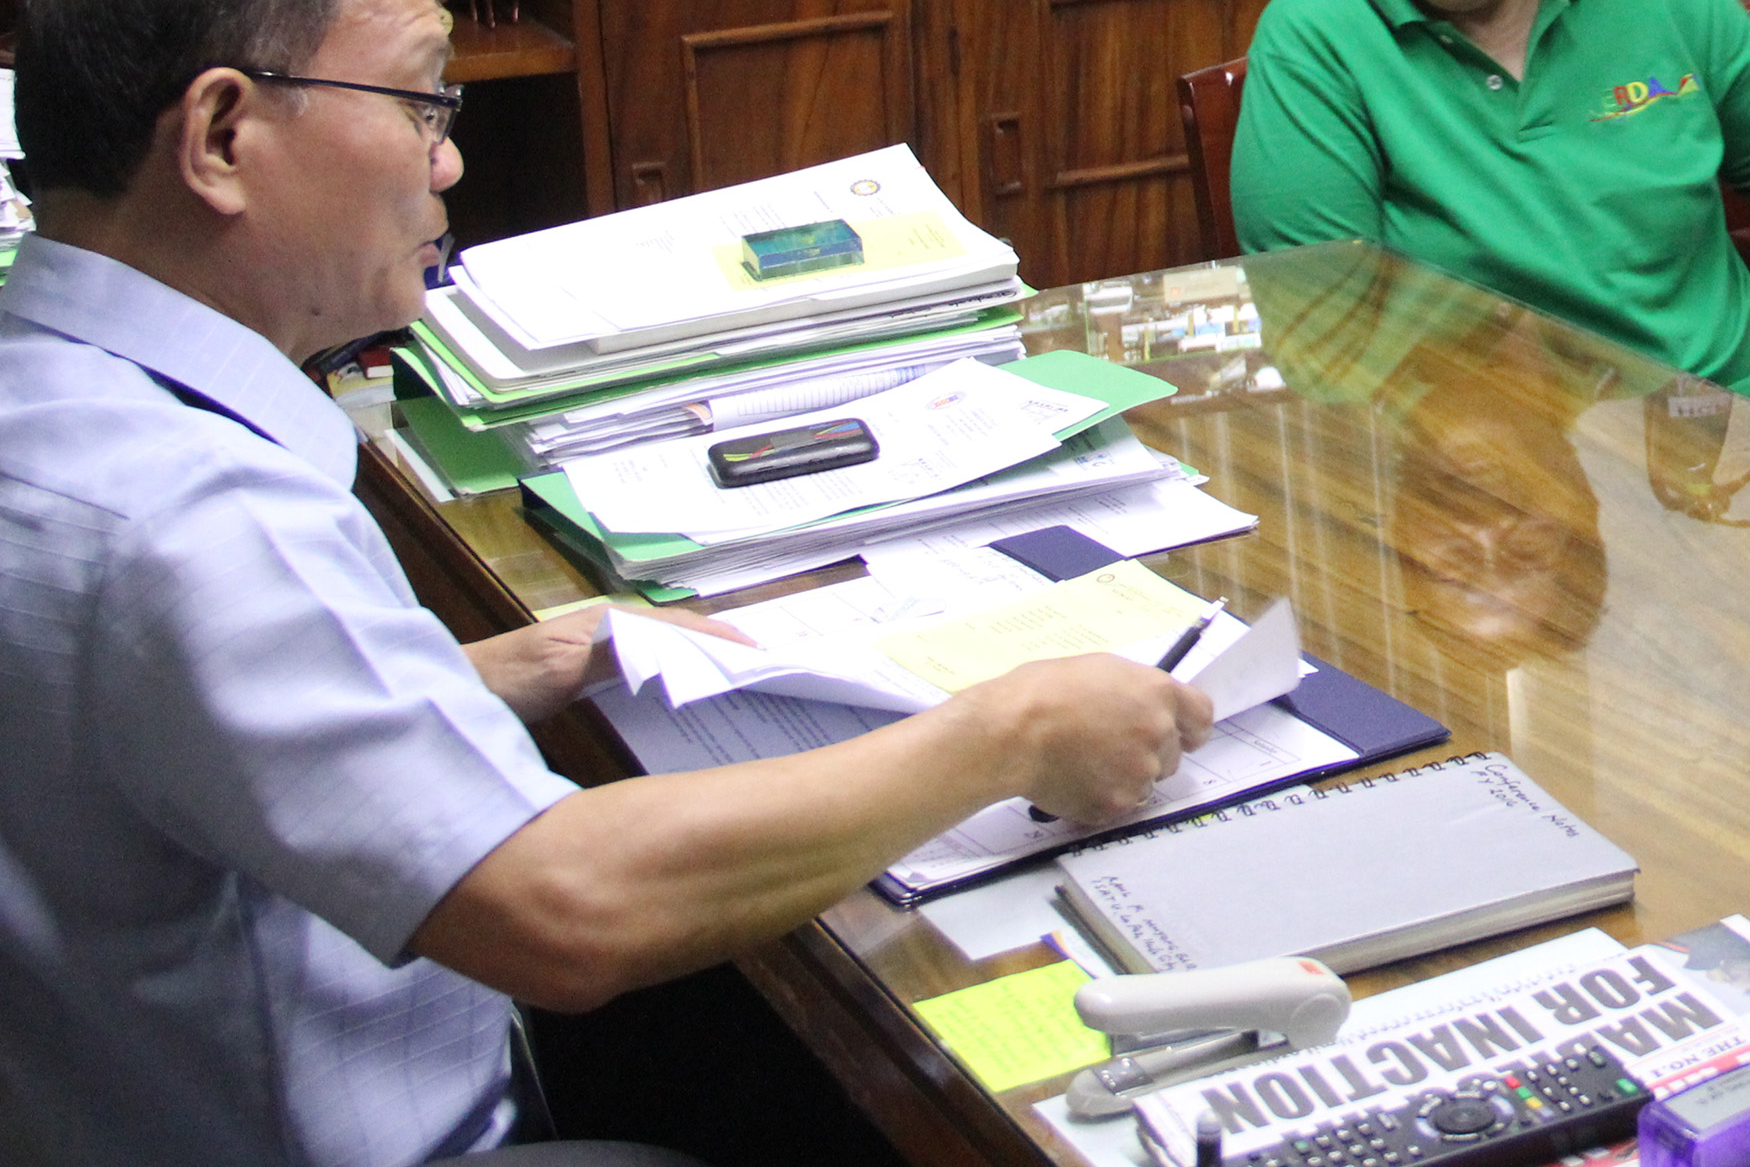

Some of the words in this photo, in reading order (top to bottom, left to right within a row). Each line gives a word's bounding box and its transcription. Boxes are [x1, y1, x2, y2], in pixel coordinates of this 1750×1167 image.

[1532, 955, 1677, 1026] FOR
[1201, 1006, 1544, 1135] INACTION
[1702, 1034, 1746, 1058] THE
